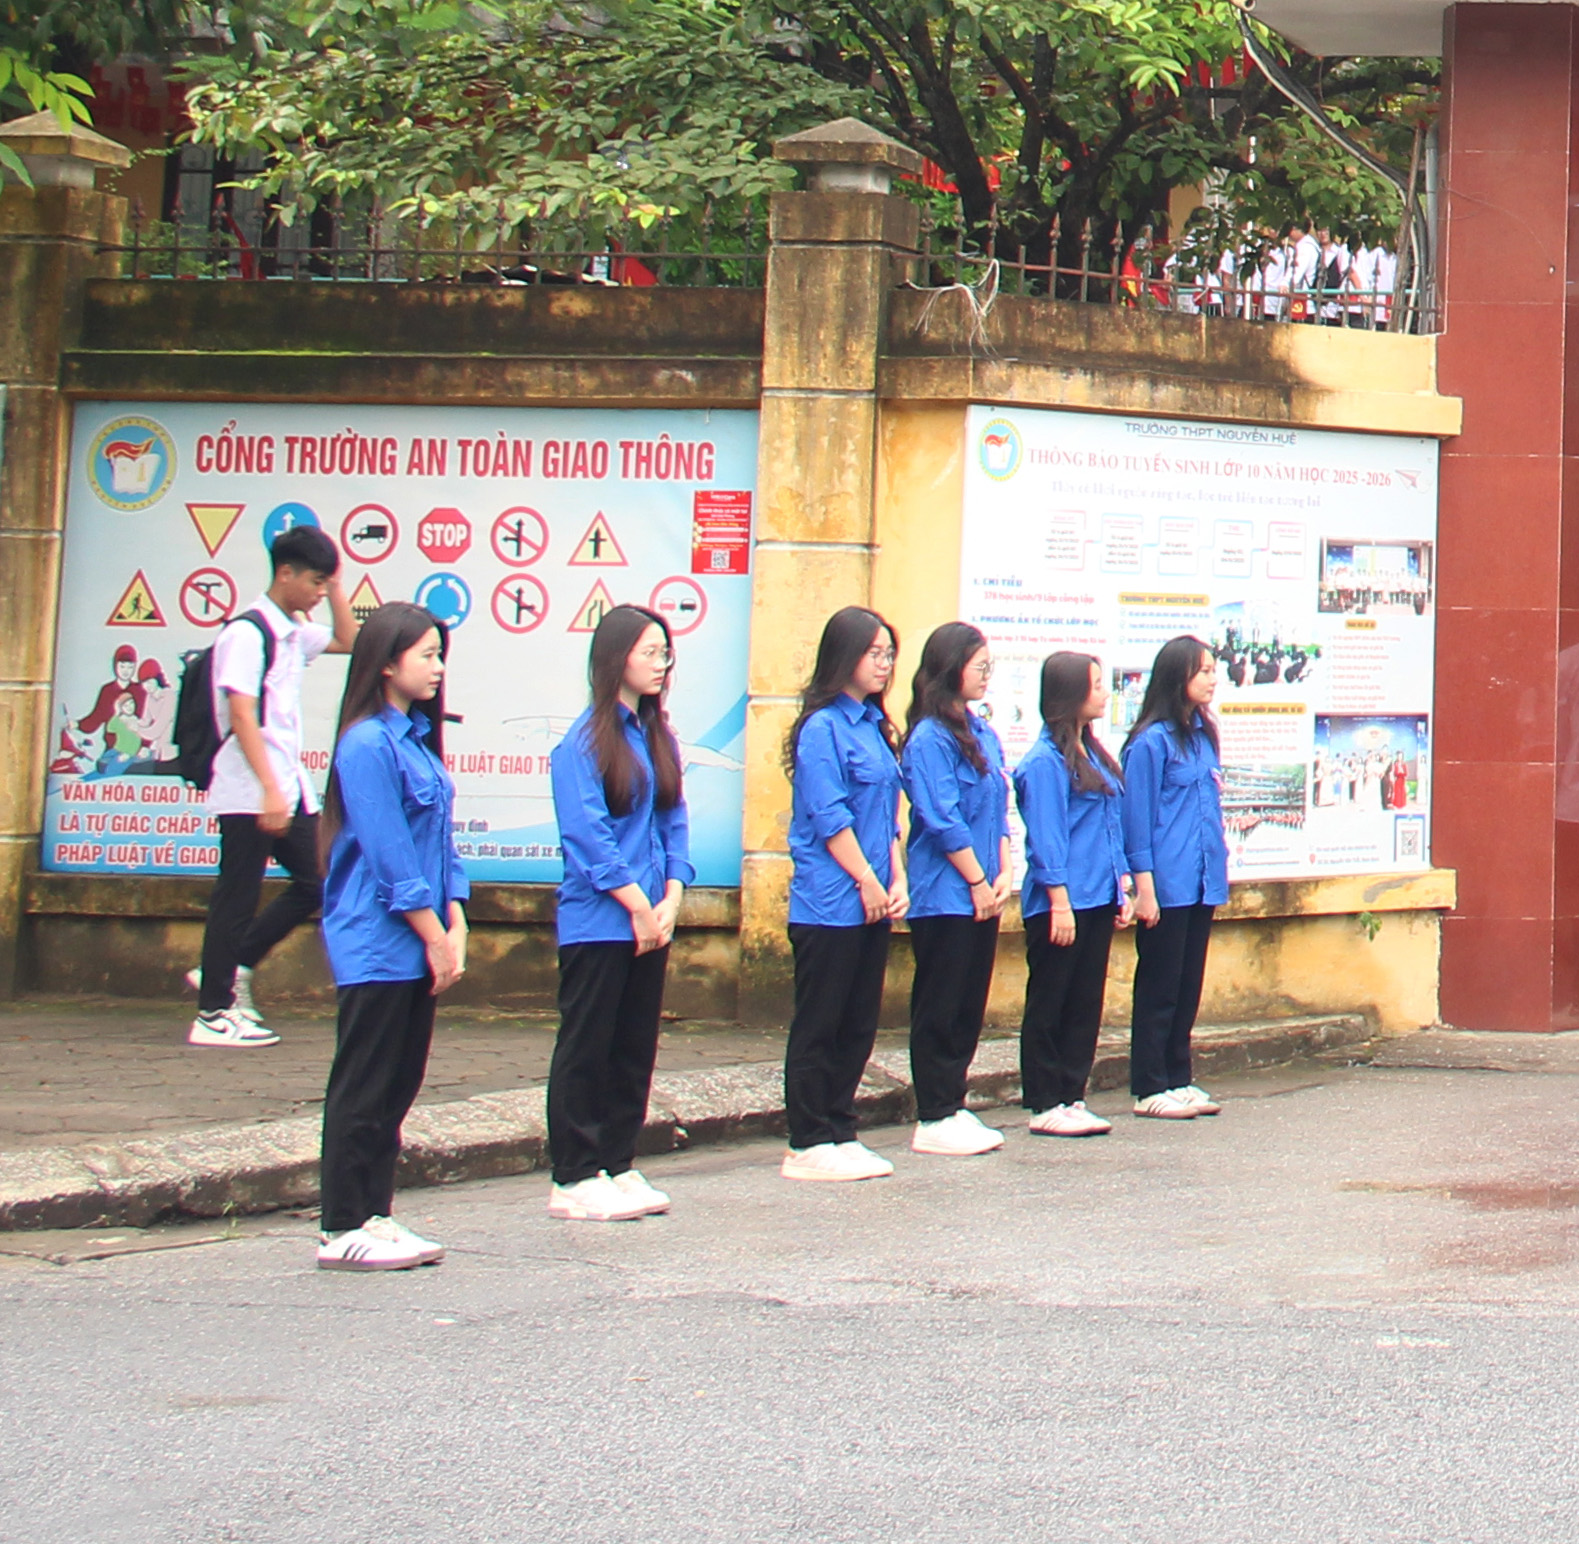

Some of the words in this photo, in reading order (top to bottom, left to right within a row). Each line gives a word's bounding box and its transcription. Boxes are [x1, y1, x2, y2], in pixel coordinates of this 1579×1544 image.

[1125, 421, 1178, 436] TRƯỜNG
[1181, 425, 1214, 438] THPT
[1217, 427, 1269, 443] NGUYỄN
[195, 419, 275, 474] CỔNG
[284, 427, 398, 475] TRƯỜNG
[406, 437, 448, 476] AN
[457, 431, 533, 478] TOÀN
[542, 439, 610, 479] GIAO
[619, 433, 716, 480] THÔNG
[1028, 446, 1084, 467] THÔNG
[1088, 449, 1119, 469] BÁO
[1123, 452, 1172, 472] TUYỂN
[1174, 459, 1210, 476] SINH
[1215, 458, 1243, 478] LỚP
[1247, 464, 1260, 479] 10
[1264, 461, 1296, 482] NĂM
[1299, 466, 1330, 486] HỌC
[1333, 469, 1359, 485] 2025
[421, 522, 468, 548] STOP
[301, 750, 329, 775] HỌC
[460, 750, 495, 777] LUẬT
[499, 755, 533, 775] GIAO
[62, 782, 98, 803] VĂN
[102, 780, 136, 803] HÓA
[140, 784, 181, 804] GIAO
[59, 812, 80, 832] LÀ
[86, 813, 109, 837] TỰ
[111, 811, 151, 834] GIÁC
[156, 810, 202, 834] CHẤP
[55, 841, 103, 863] PHÁP
[107, 843, 149, 868] LUẬT
[153, 842, 175, 864] VỀ
[179, 846, 219, 865] GIAO
